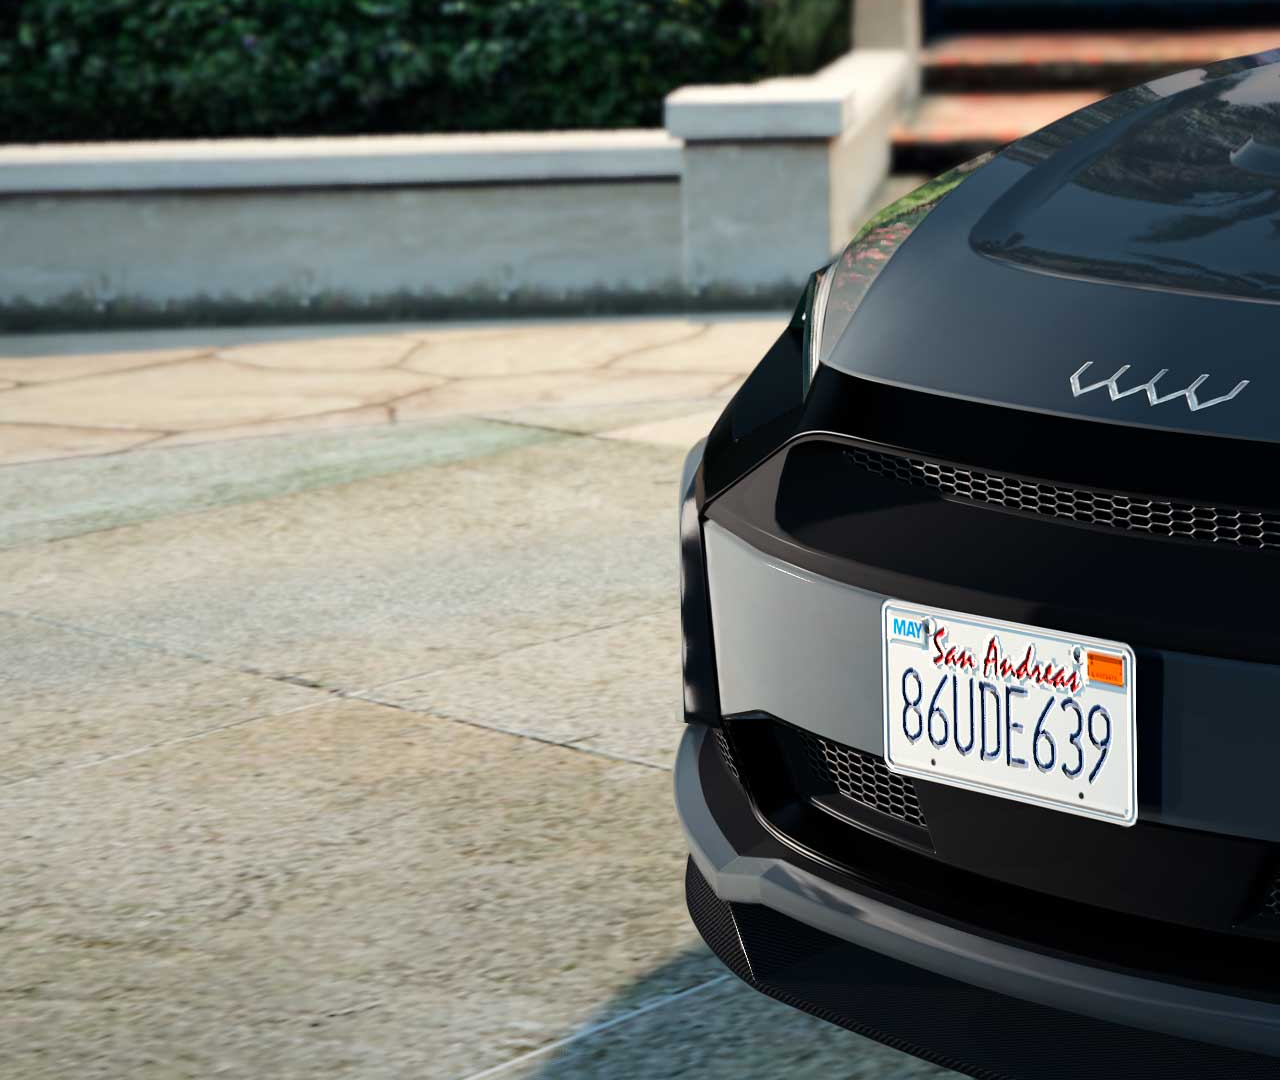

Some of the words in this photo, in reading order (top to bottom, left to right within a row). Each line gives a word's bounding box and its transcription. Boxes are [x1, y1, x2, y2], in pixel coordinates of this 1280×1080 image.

[893, 618, 922, 639] MAY
[932, 626, 977, 669] San
[982, 636, 1080, 693] Andreas
[902, 667, 1112, 784] 86UDE639
